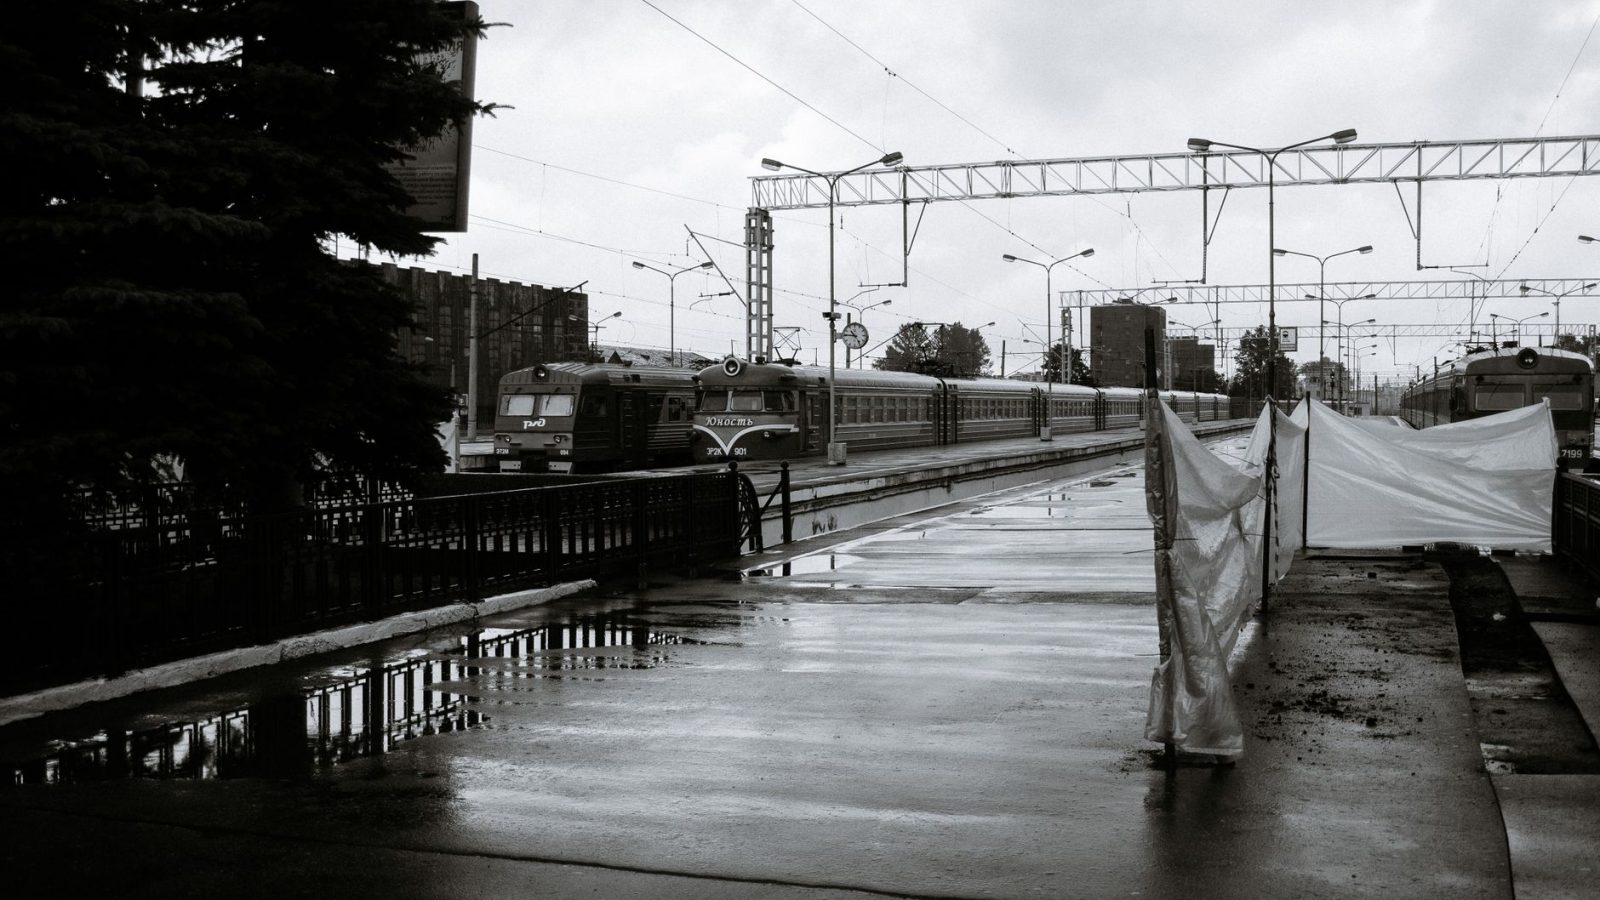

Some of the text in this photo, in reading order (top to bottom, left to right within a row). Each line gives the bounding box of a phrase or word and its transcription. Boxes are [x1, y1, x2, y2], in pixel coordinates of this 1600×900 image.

[705, 416, 753, 426] Юность
[734, 447, 747, 456] 901
[1561, 449, 1583, 458] 7199
